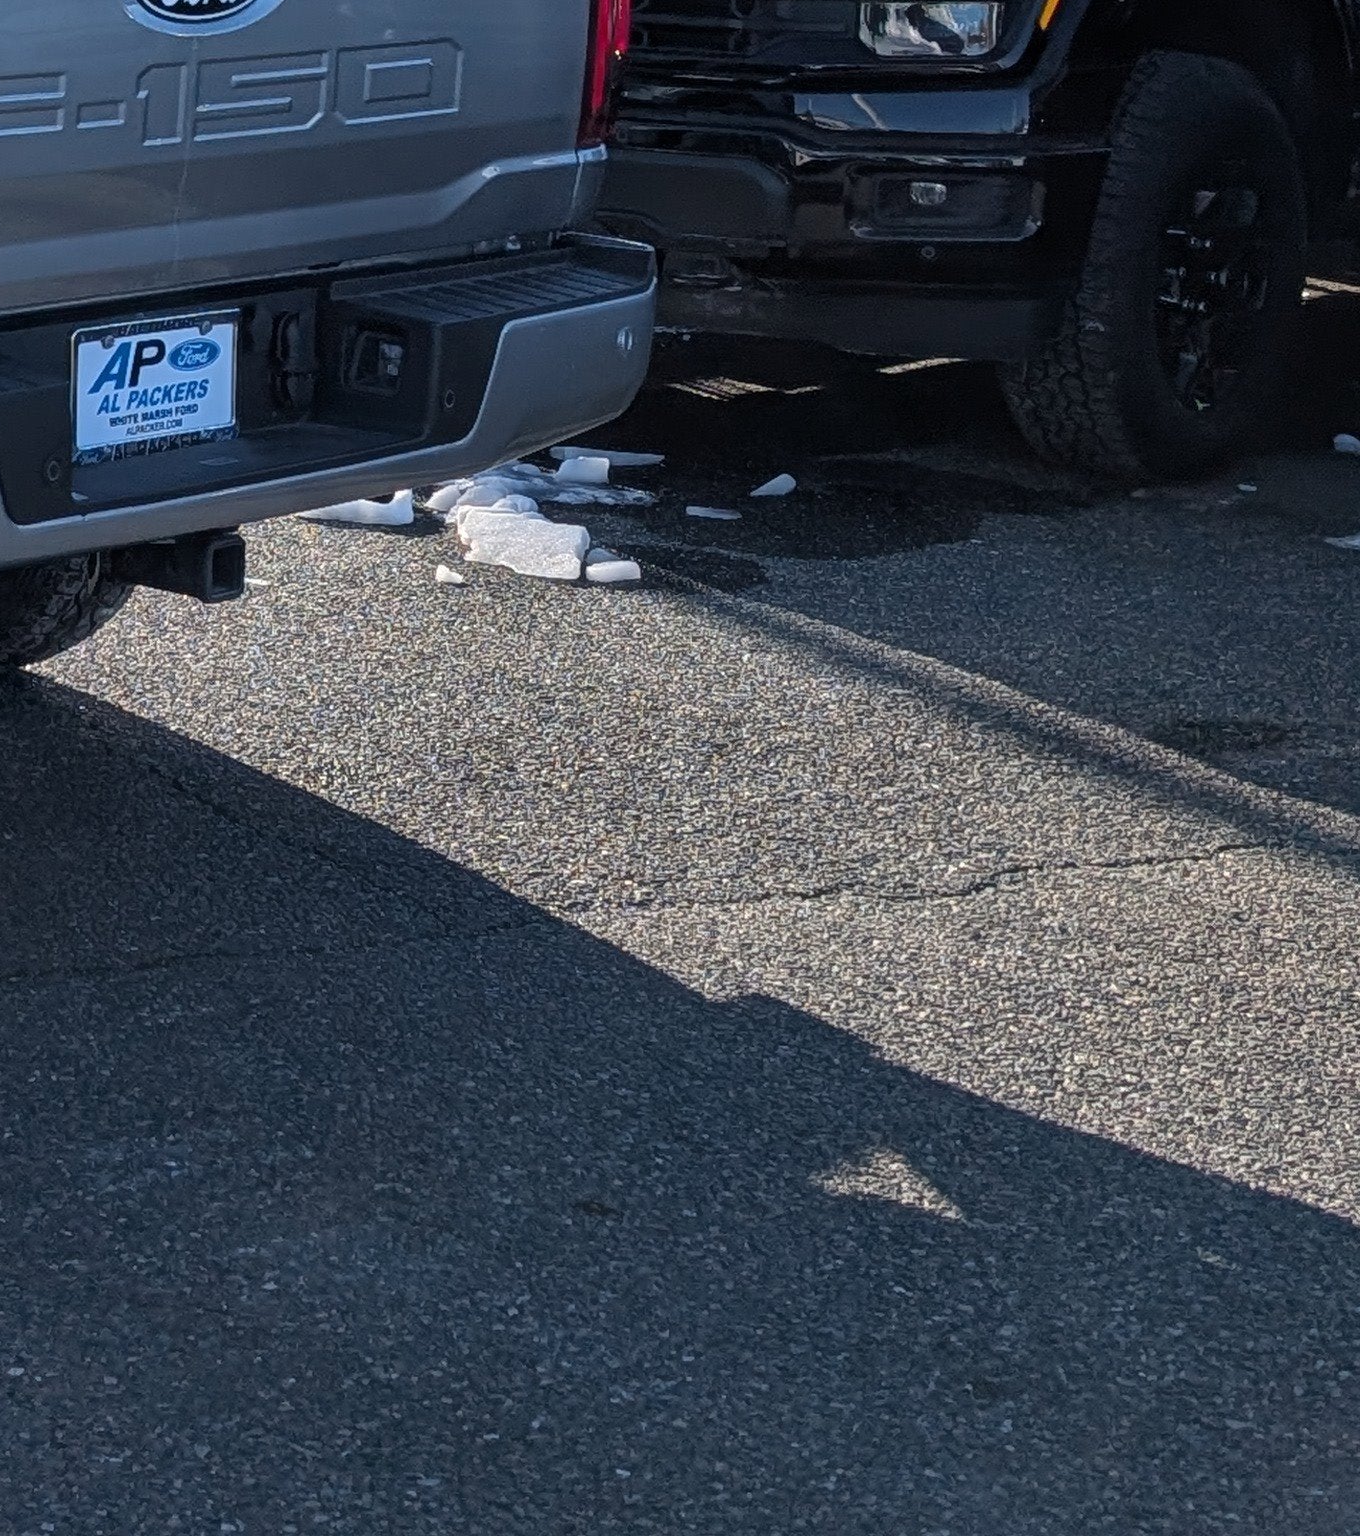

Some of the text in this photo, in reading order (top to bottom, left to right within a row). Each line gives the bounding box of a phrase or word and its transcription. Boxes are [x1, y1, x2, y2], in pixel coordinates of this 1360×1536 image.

[87, 338, 211, 395] AP Ford
[96, 378, 210, 416] AL PACKERS
[141, 407, 173, 422] MARSH
[175, 403, 199, 417] FORD
